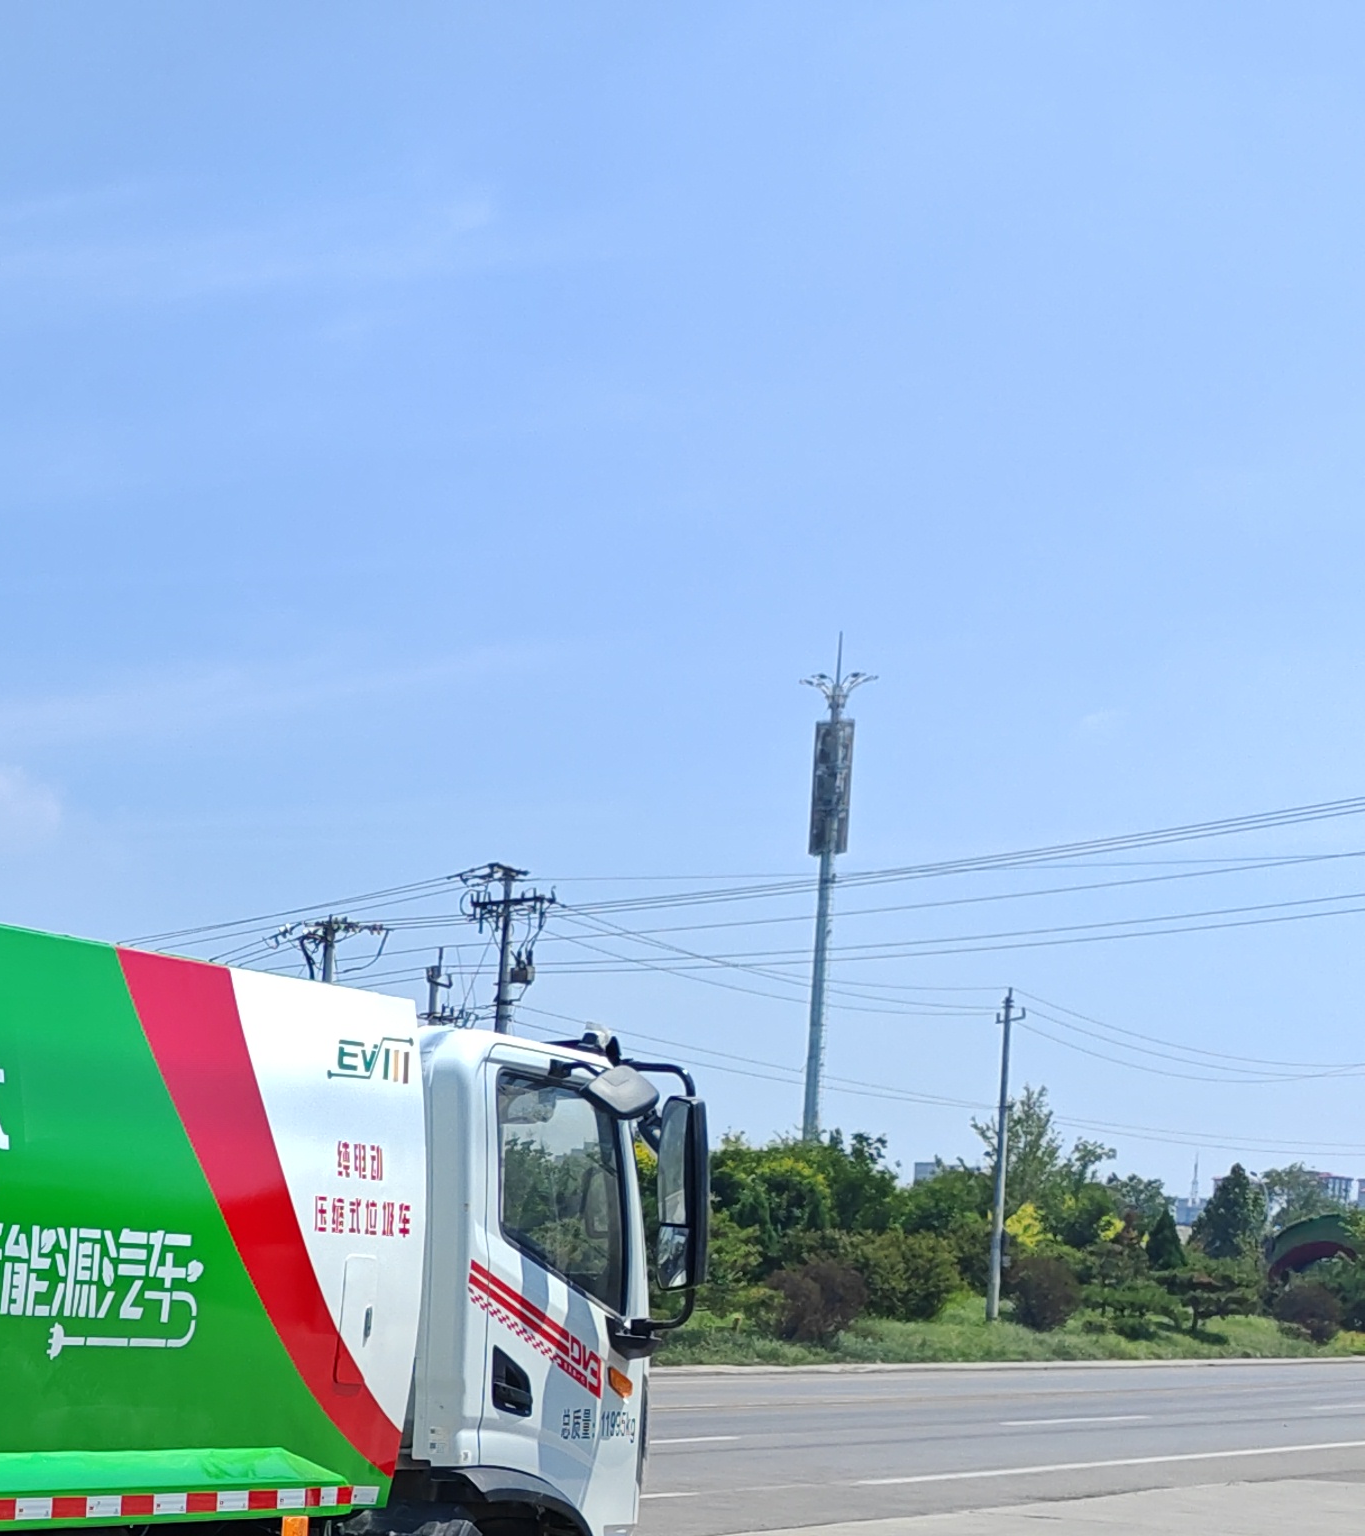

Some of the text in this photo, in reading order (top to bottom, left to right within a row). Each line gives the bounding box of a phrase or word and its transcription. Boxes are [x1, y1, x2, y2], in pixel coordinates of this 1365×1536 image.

[337, 1140, 383, 1181] 纯电动
[314, 1195, 411, 1239] 压缩式垃圾车
